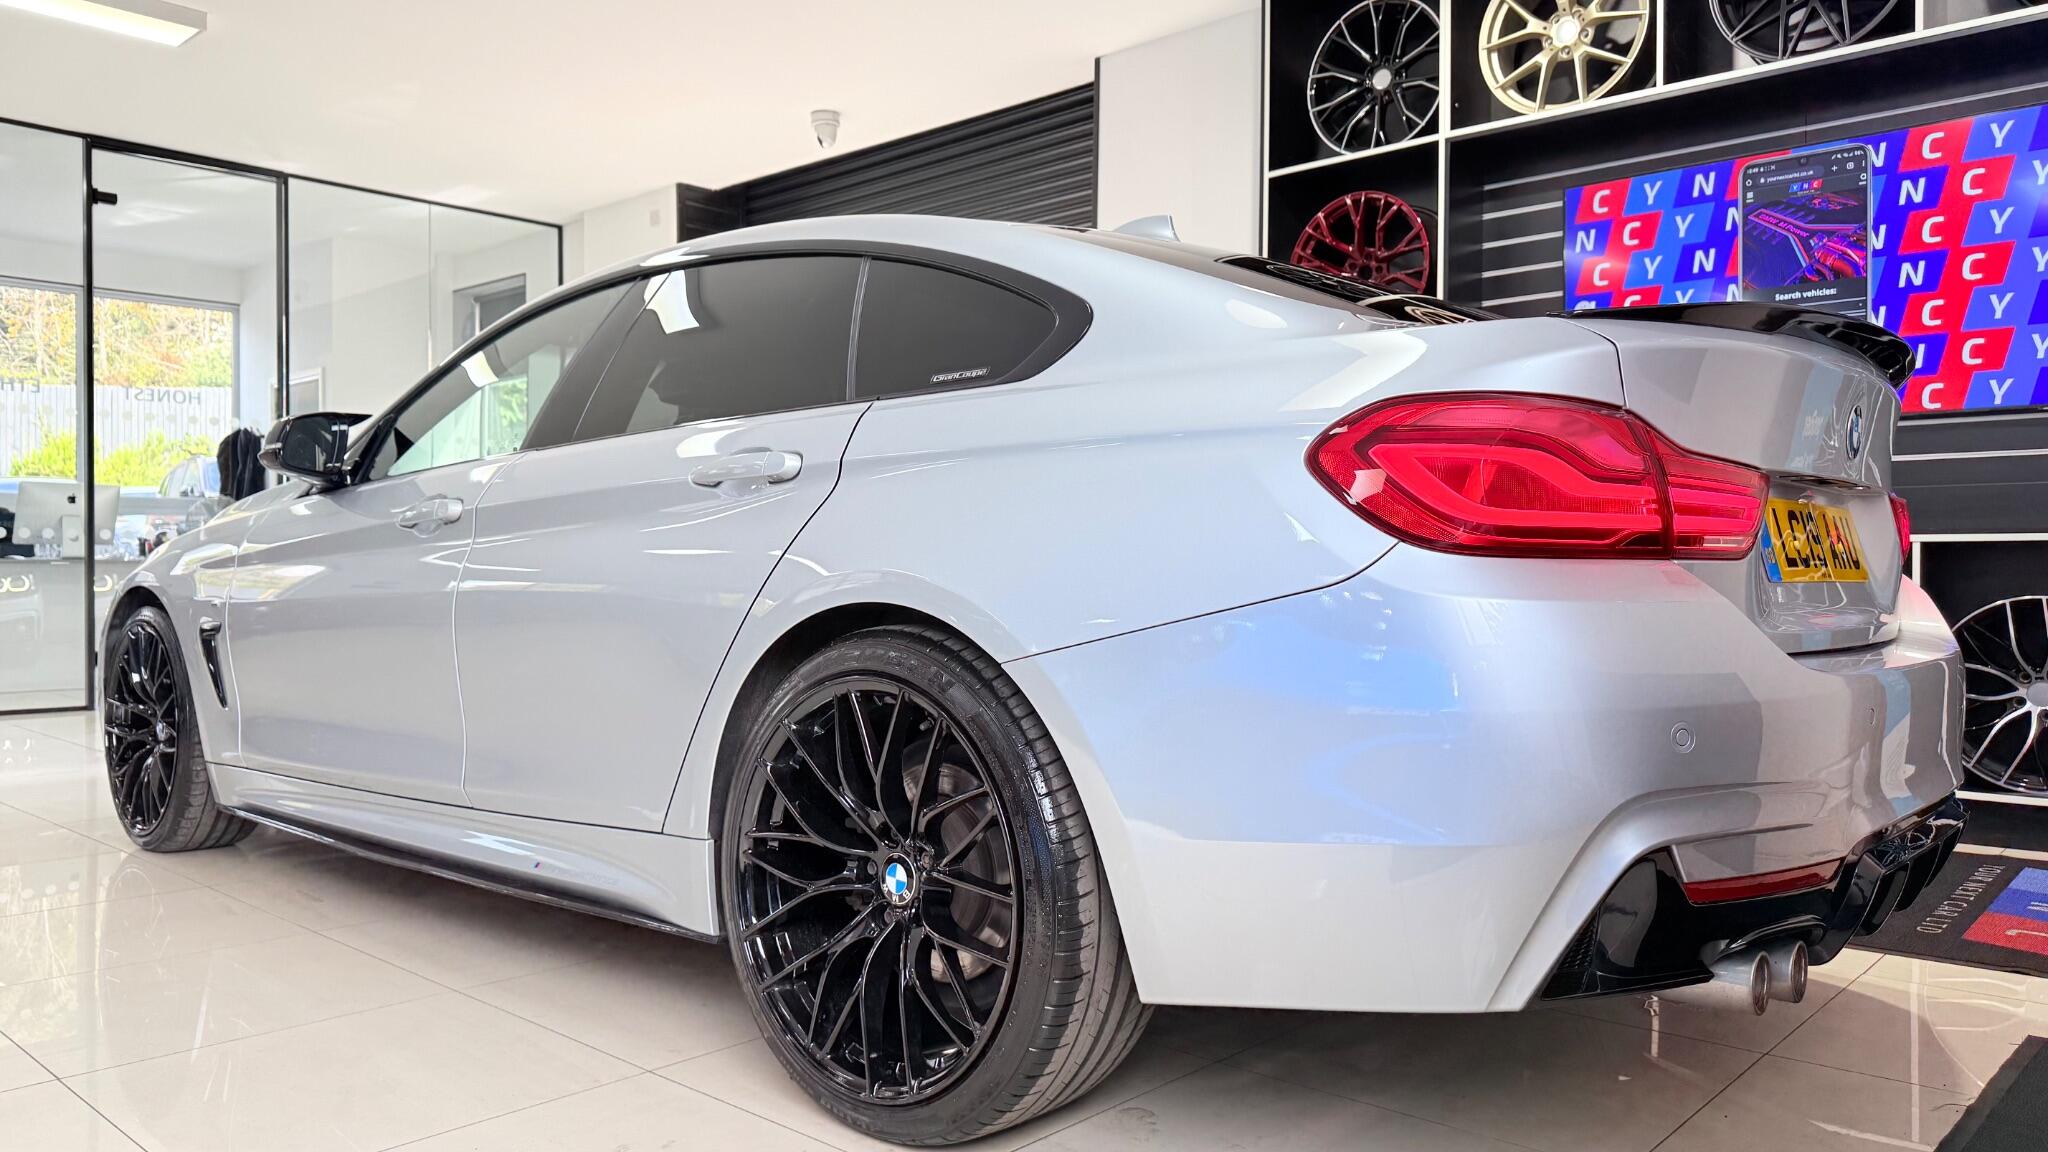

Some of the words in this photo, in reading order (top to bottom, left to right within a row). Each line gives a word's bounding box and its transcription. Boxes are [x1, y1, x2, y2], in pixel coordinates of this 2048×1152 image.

[1593, 189, 1611, 213] C
[1643, 180, 1663, 205] Y
[1692, 171, 1716, 198] N
[1921, 132, 1945, 160] C
[1989, 120, 2015, 148] Y
[1575, 228, 1596, 253] N
[1622, 221, 1641, 245] C
[1675, 213, 1695, 238] Y
[1898, 177, 1926, 206] N
[1962, 168, 1986, 196] C
[1593, 263, 1611, 287] C
[1643, 255, 1663, 280] Y
[1692, 248, 1716, 274] N
[1921, 216, 1945, 243] C
[1989, 207, 2015, 234] Y
[1898, 260, 1926, 288] N
[1961, 252, 1985, 280] C
[1775, 291, 1801, 301] Search
[1802, 288, 1837, 298] vehicles:
[1921, 299, 1945, 326] C
[1989, 292, 2015, 319] Y
[1961, 338, 1985, 365] C
[1921, 383, 1945, 409] C
[1989, 378, 2015, 405] Y
[1969, 864, 2006, 882] YOUR
[1951, 881, 1987, 900] NEXT
[1932, 901, 1968, 917] CAR
[1916, 917, 1952, 933] LTD
